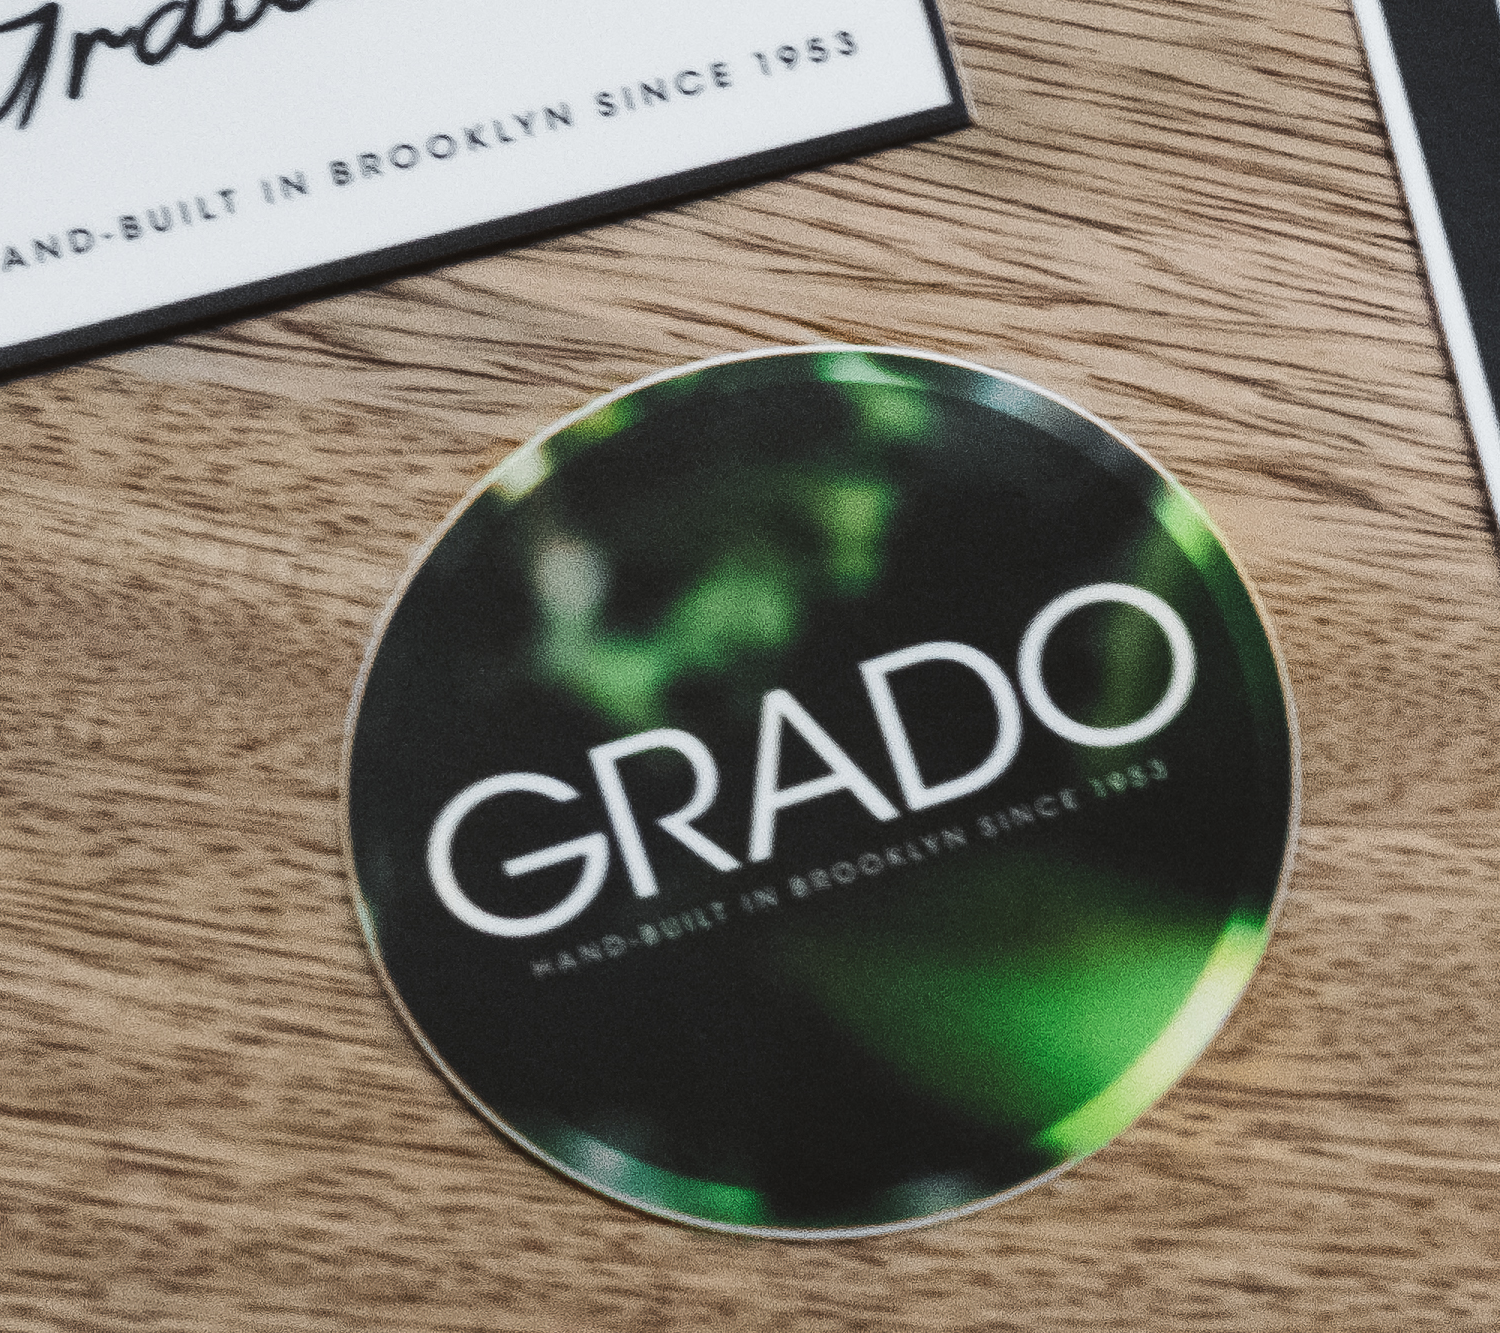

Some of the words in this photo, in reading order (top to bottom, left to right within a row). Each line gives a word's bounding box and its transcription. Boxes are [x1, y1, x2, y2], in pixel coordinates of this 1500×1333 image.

[261, 169, 309, 205] IN
[328, 100, 576, 189] BROOKLYN
[593, 59, 734, 120] SINCE
[752, 28, 860, 77] 1953
[426, 581, 1196, 938] GRADO
[530, 900, 730, 979] HAND-BUILT
[740, 887, 780, 914] IN
[787, 826, 968, 899] BROOKLYN
[977, 787, 1080, 839] SINCE
